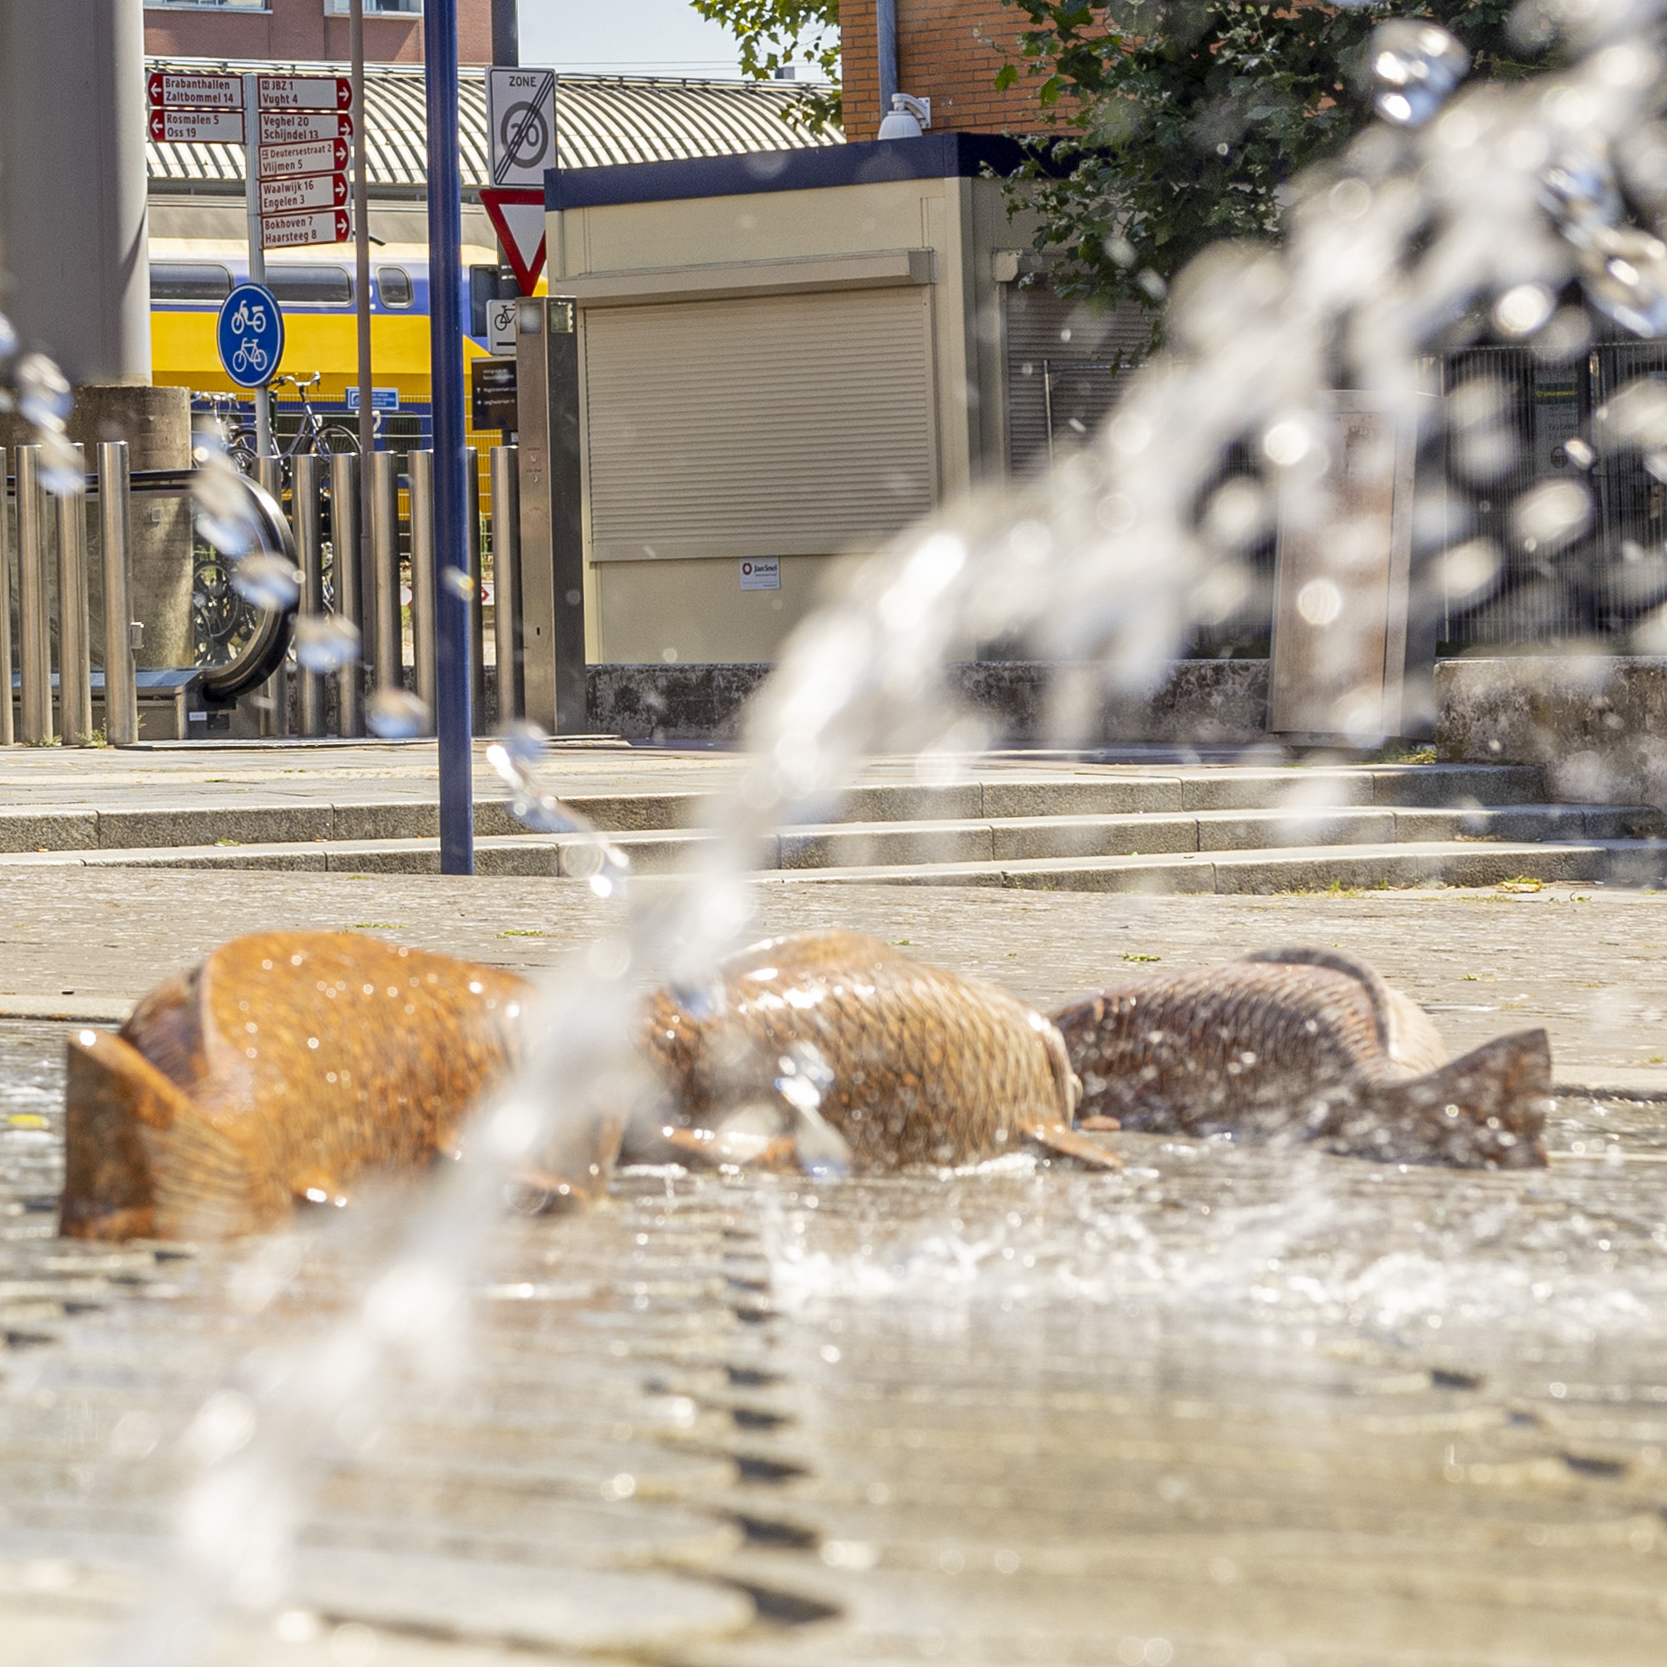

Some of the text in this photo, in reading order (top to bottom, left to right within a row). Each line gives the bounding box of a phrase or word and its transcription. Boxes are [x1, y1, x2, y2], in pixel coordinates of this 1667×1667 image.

[165, 78, 230, 90] Brabanthallen
[271, 81, 287, 91] JBZ
[289, 81, 293, 91] 1
[509, 76, 537, 87] ZONE
[166, 92, 234, 103] Zaltbommel 14
[262, 93, 298, 106] Vught 4
[167, 114, 220, 125] Rosmalen 5
[263, 116, 309, 129] Veghel 20
[167, 127, 197, 138] Oss 19
[264, 129, 319, 141] Schijndel 13
[270, 144, 332, 159] Deutersestraat 2
[263, 159, 303, 173] Vlijmen 5
[263, 180, 314, 194] Waalwijk 16
[264, 195, 305, 209] Engelen 3
[265, 216, 313, 230] Bokhoven 7
[265, 229, 317, 243] Haarsteeg 8
